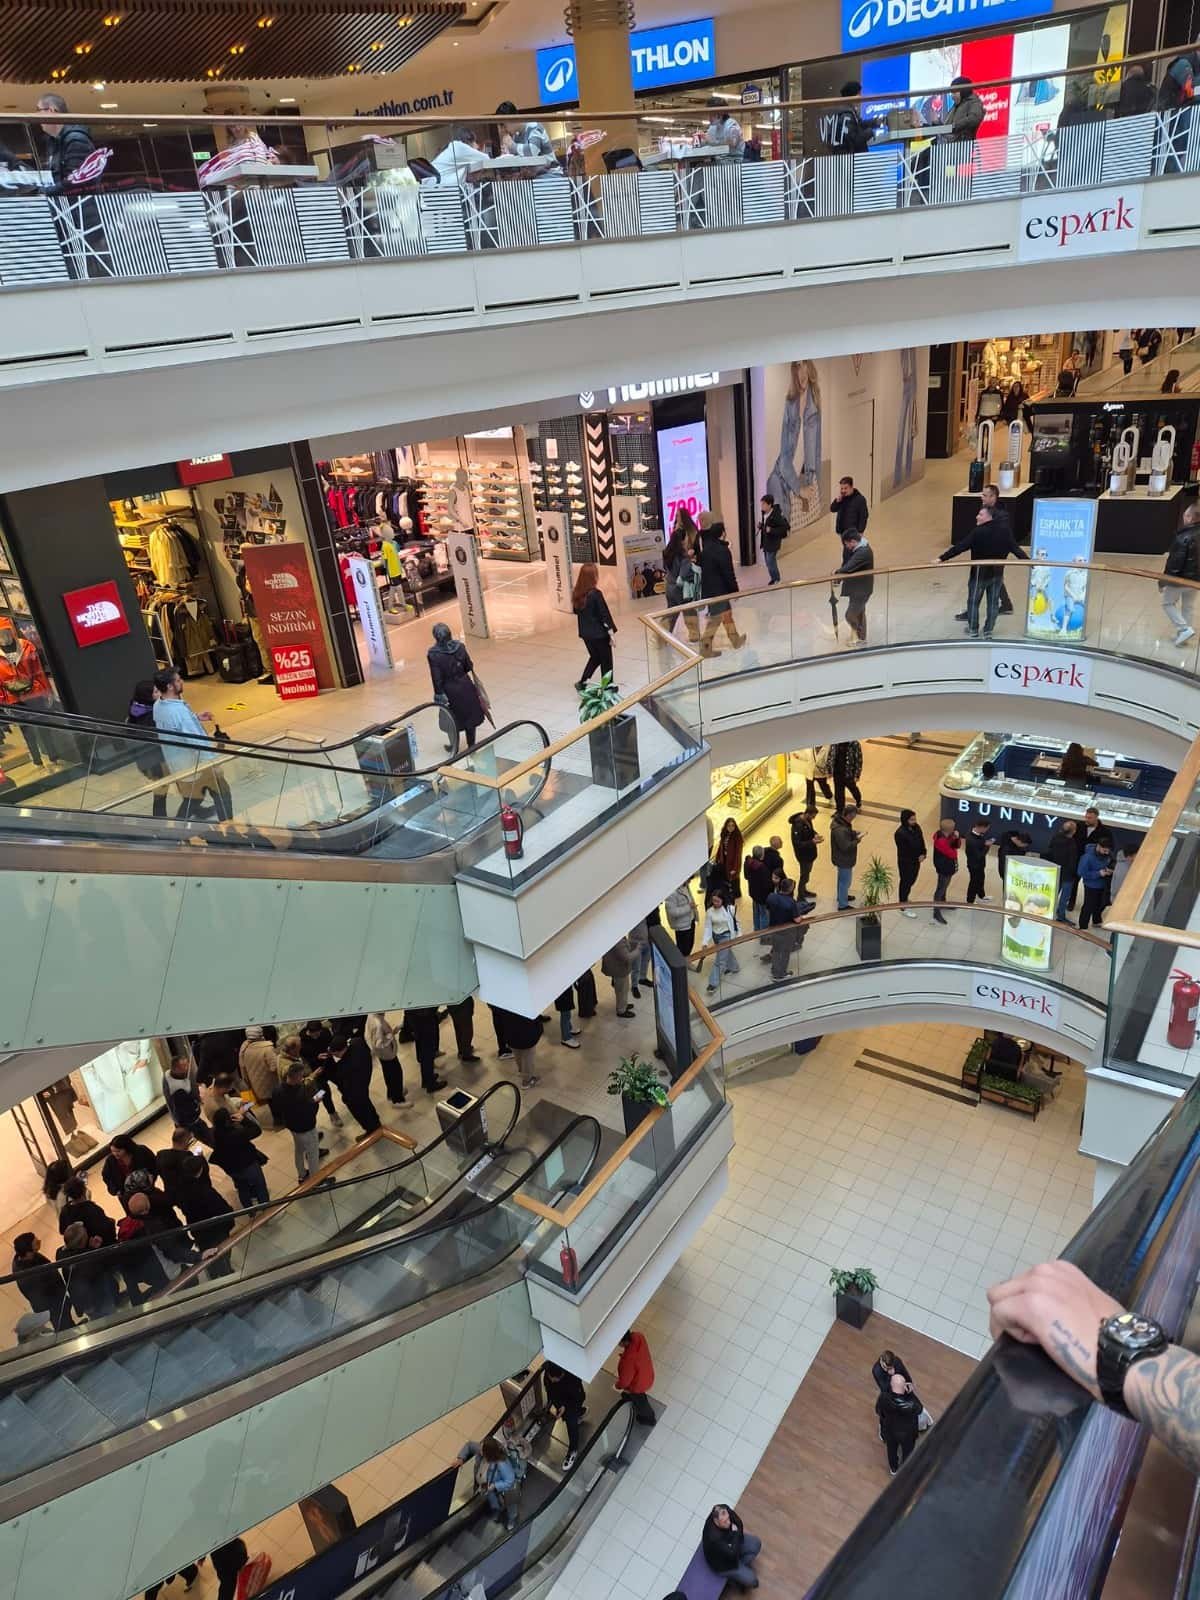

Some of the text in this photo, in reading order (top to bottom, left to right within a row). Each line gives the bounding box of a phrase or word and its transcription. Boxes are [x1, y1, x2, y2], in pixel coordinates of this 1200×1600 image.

[1025, 196, 1135, 247] espark
[270, 610, 307, 622] SEZON
[274, 649, 311, 669] %25
[994, 662, 1085, 688] espark
[958, 799, 1059, 829] BUNNY
[976, 984, 1056, 1017] espark
